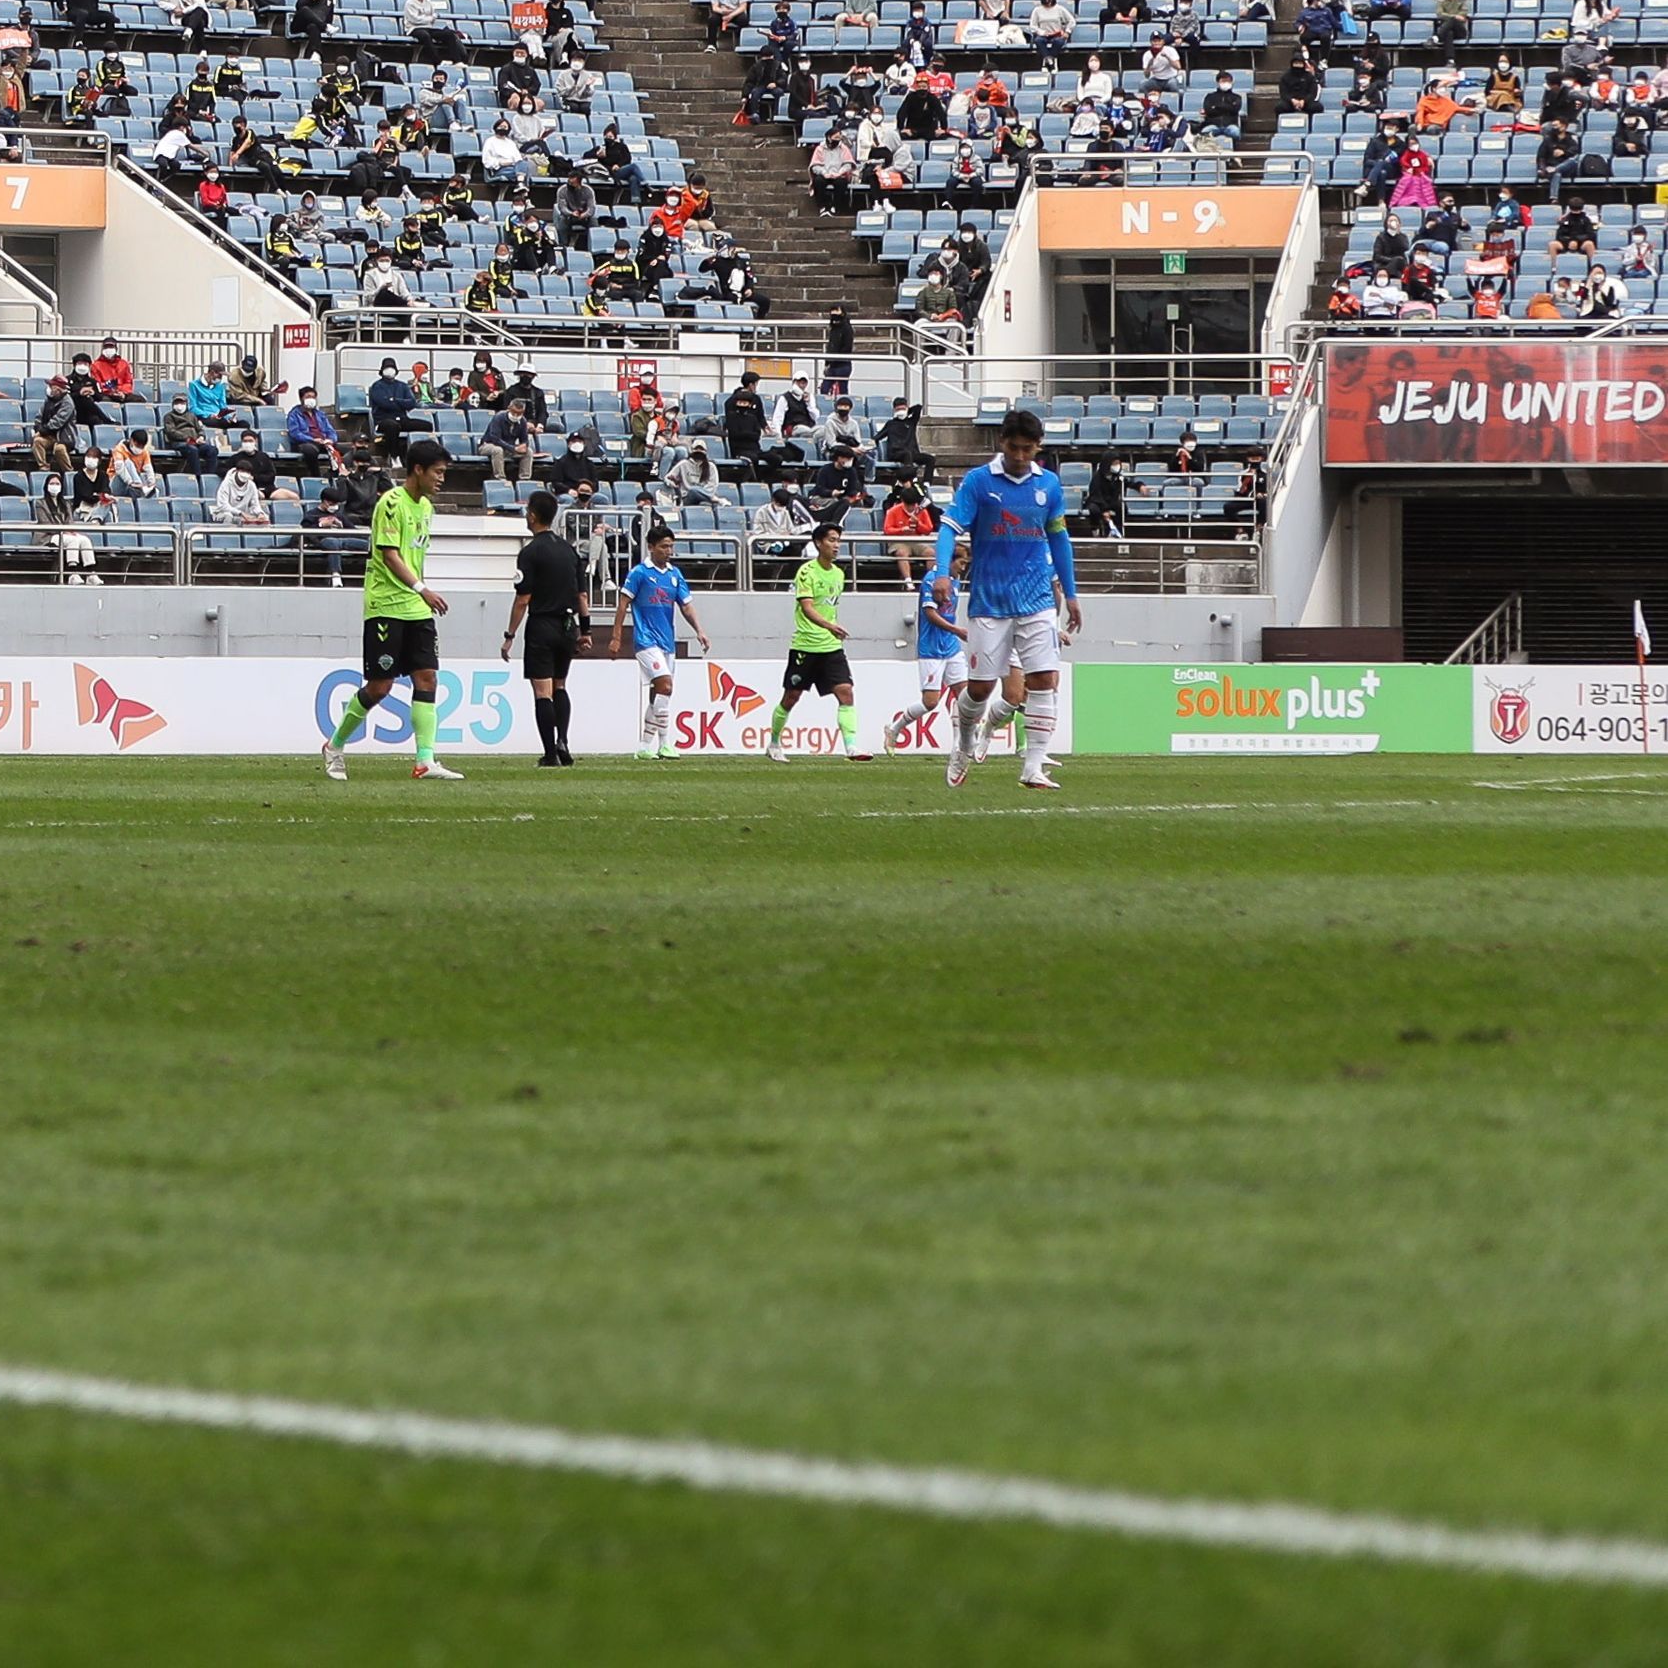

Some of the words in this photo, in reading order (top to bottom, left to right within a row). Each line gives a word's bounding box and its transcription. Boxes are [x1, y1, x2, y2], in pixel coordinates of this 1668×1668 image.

[1378, 382, 1489, 424] JEJU
[1501, 380, 1664, 422] UNITED
[1172, 668, 1218, 683] EnClean
[1589, 684, 1668, 706] 광고문의
[314, 668, 514, 745] GS25
[1176, 675, 1282, 719] solux
[675, 711, 725, 751] SK
